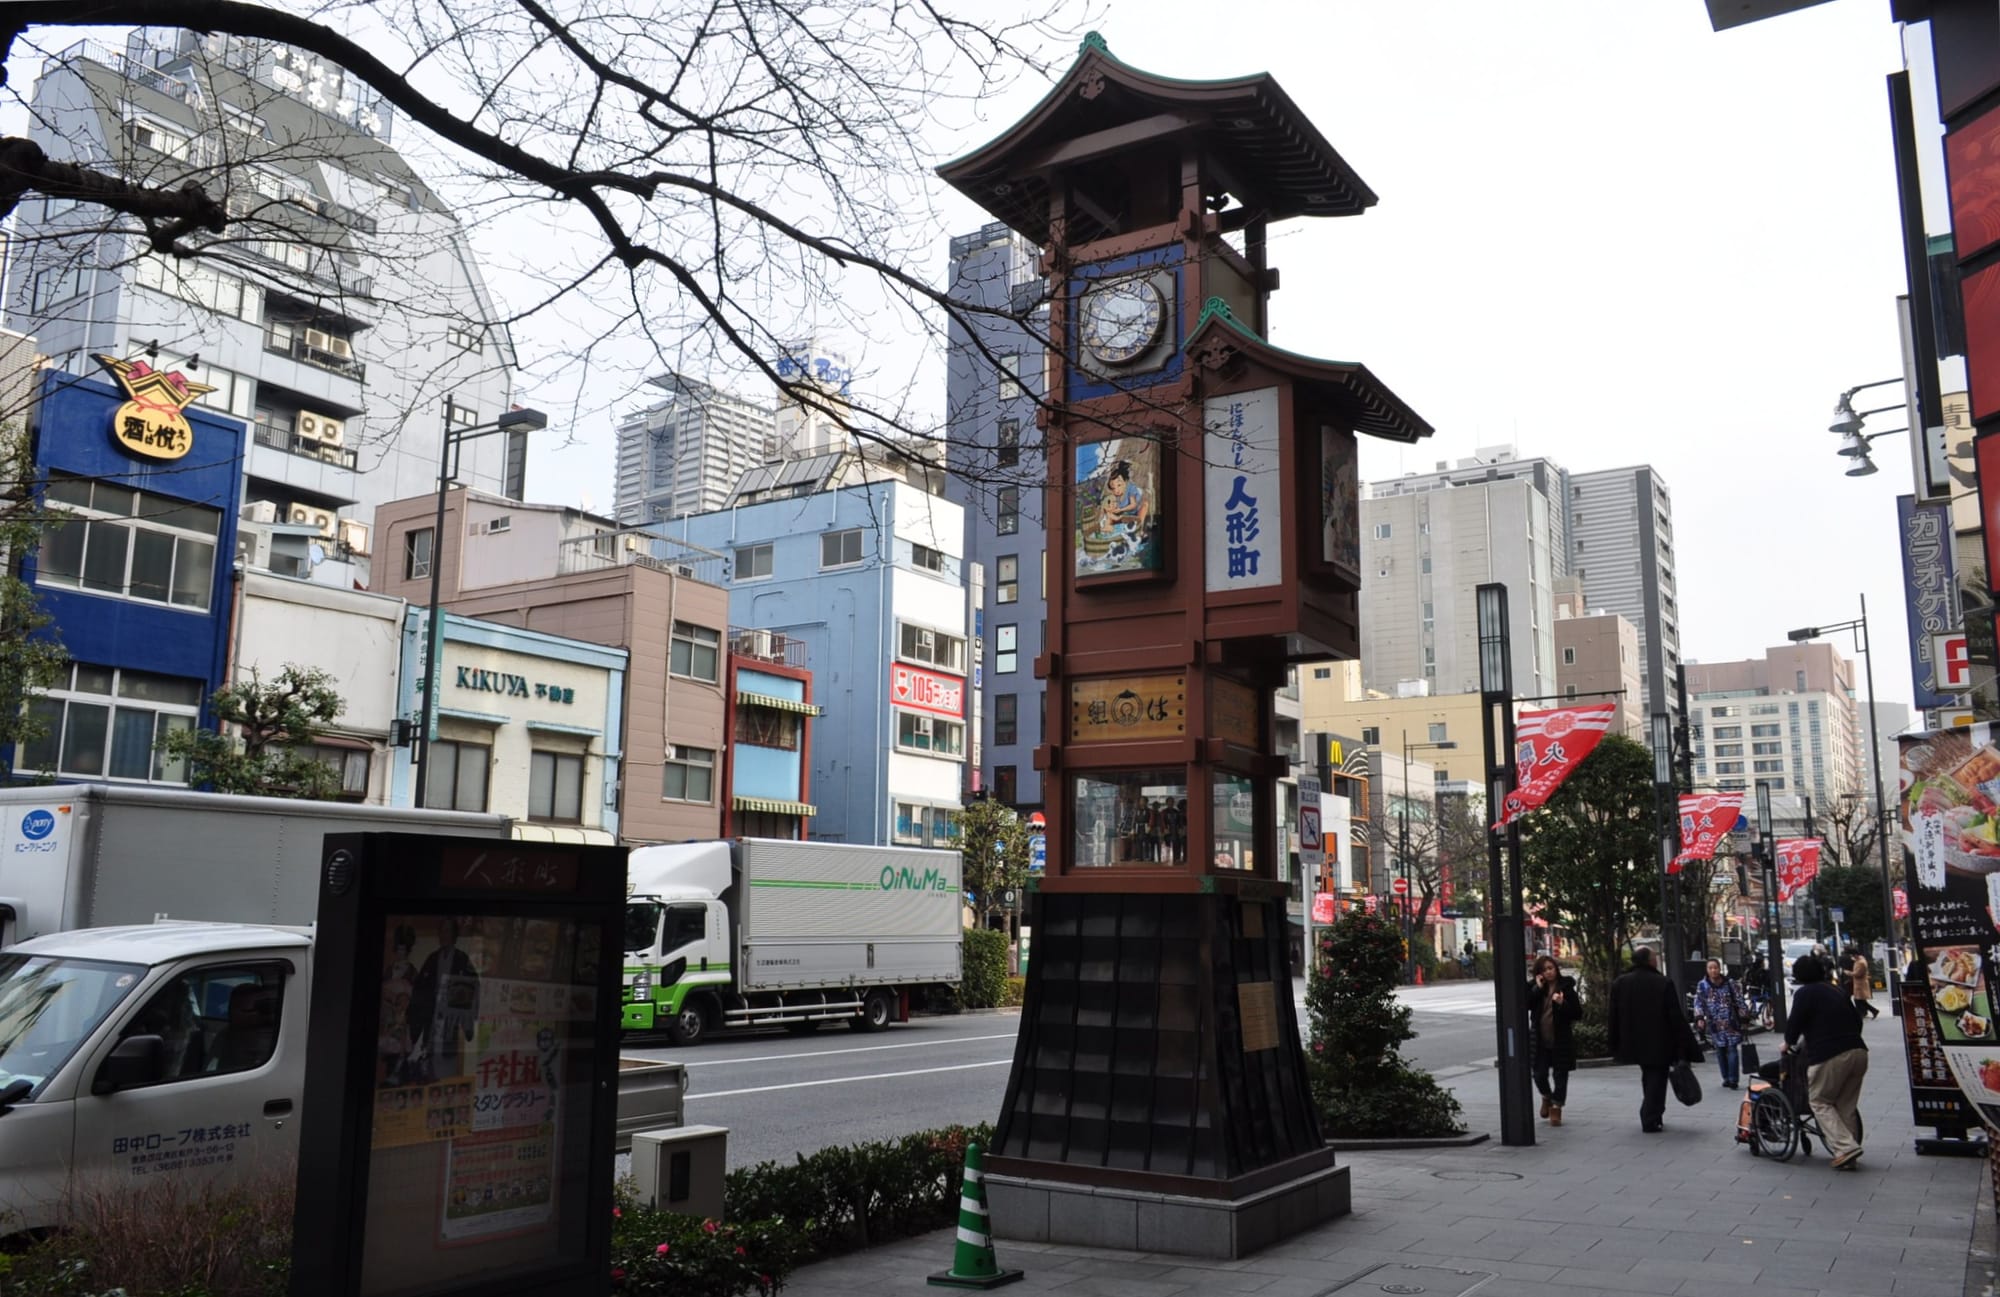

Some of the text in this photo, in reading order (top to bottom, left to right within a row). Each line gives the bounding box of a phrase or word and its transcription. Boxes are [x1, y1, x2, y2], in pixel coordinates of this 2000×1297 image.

[1225, 475, 1260, 578] 人形町
[535, 682, 574, 704] 不動産
[1087, 695, 1168, 726] 組 は
[477, 1050, 541, 1088] 千社札
[112, 1122, 251, 1154] 田中ロープ株式会社
